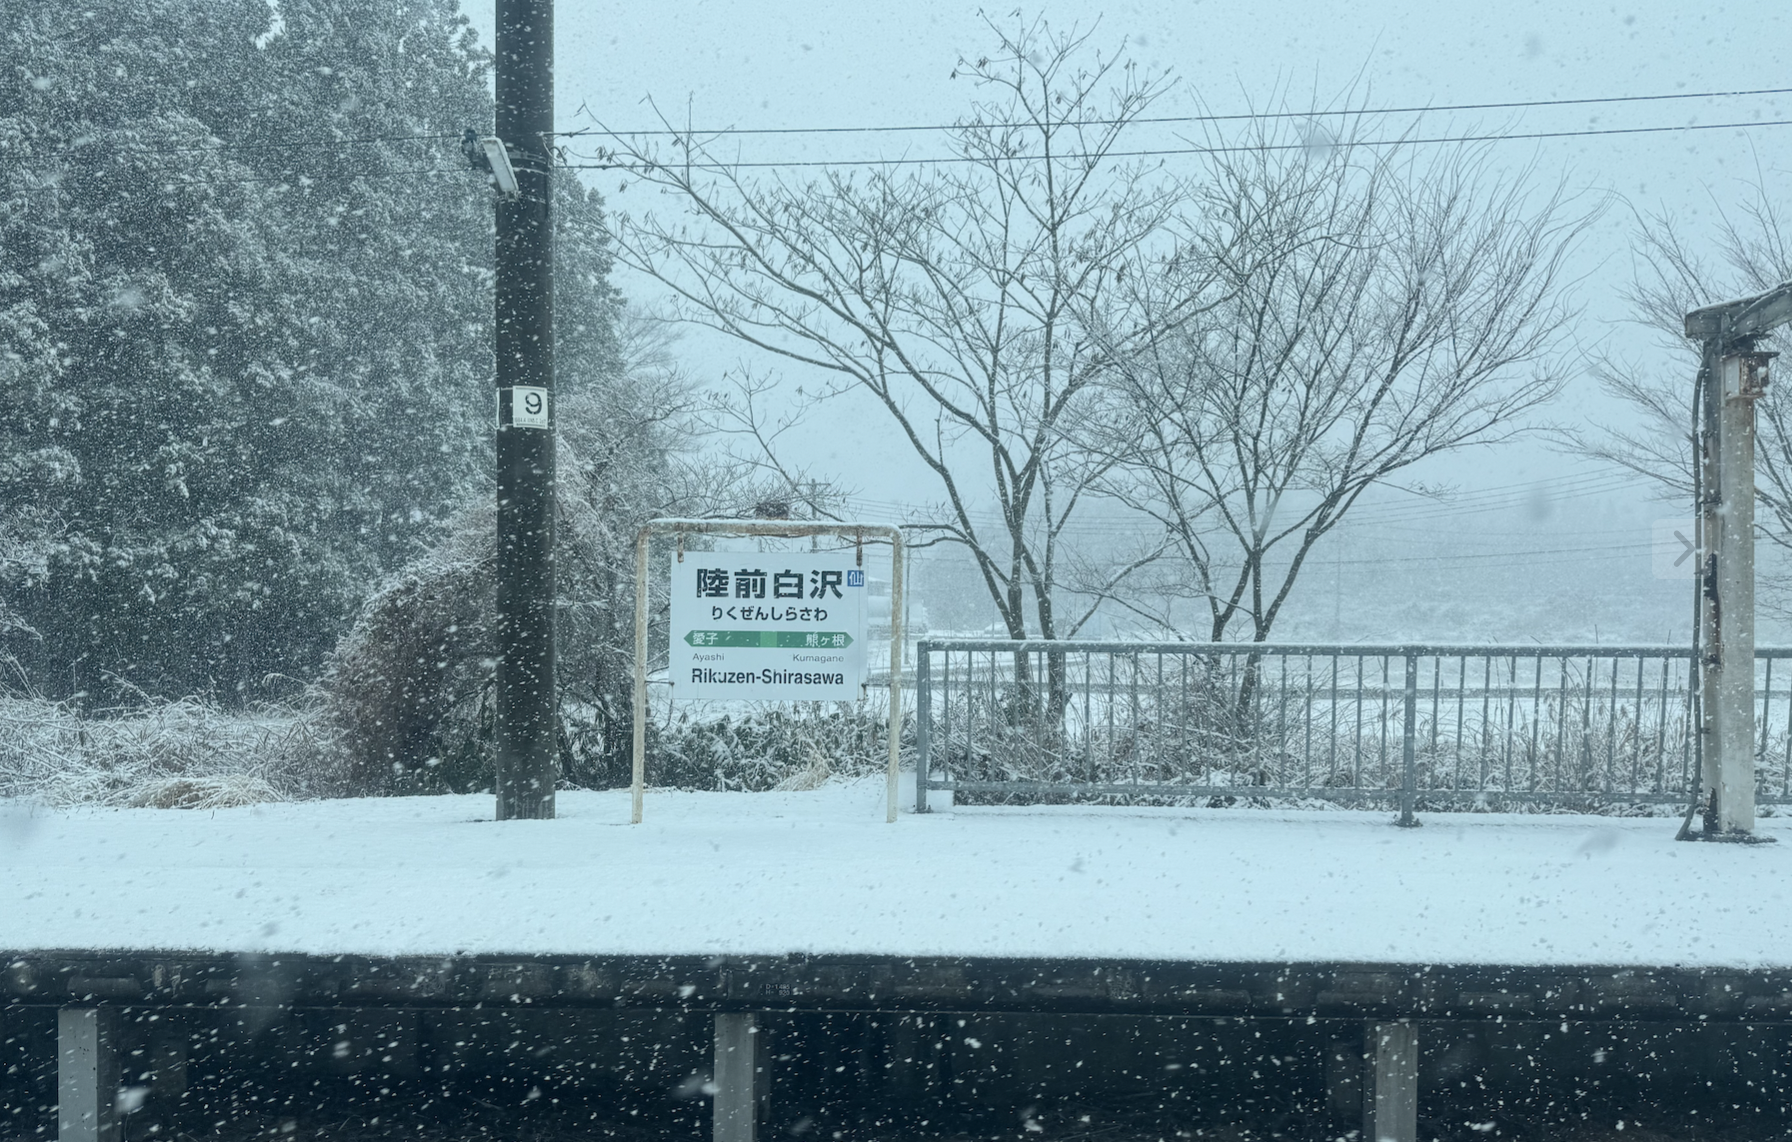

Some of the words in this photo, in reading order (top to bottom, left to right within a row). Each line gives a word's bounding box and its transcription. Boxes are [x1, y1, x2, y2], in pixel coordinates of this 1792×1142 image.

[525, 392, 542, 415] 9
[696, 568, 843, 600] 陸前白沢
[848, 570, 864, 587] 仙
[712, 605, 828, 621] りくぜんしらさわ
[692, 653, 725, 663] Ayashi
[792, 654, 844, 664] Kumagane
[692, 668, 844, 685] Rikuzen-Shirasawa
